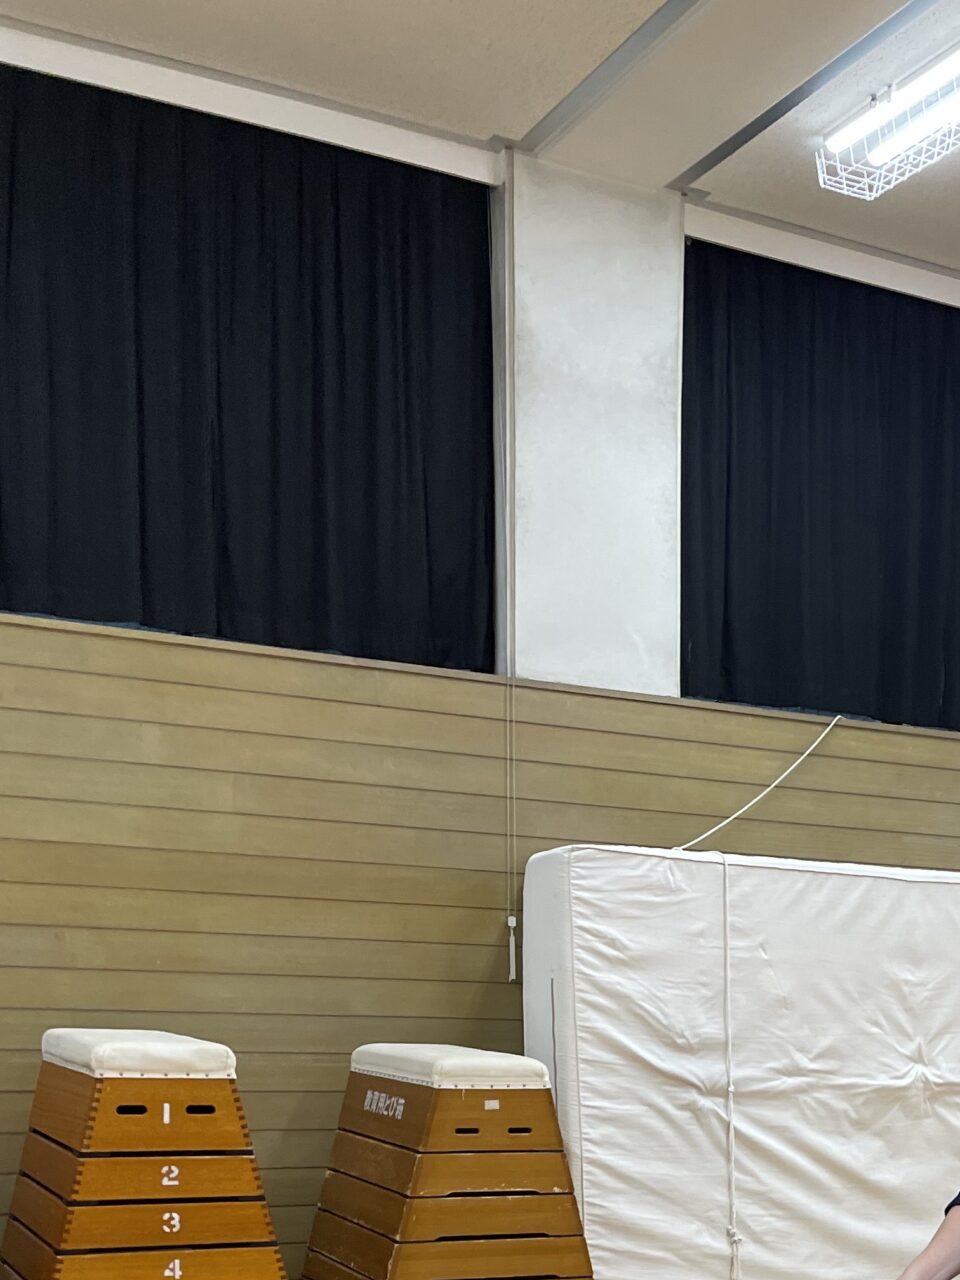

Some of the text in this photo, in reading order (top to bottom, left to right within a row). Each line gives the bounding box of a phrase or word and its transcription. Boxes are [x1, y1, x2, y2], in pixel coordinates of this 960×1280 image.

[163, 1103, 171, 1125] 1
[161, 1165, 180, 1186] 2
[162, 1212, 181, 1233] 3
[163, 1259, 182, 1280] 4
